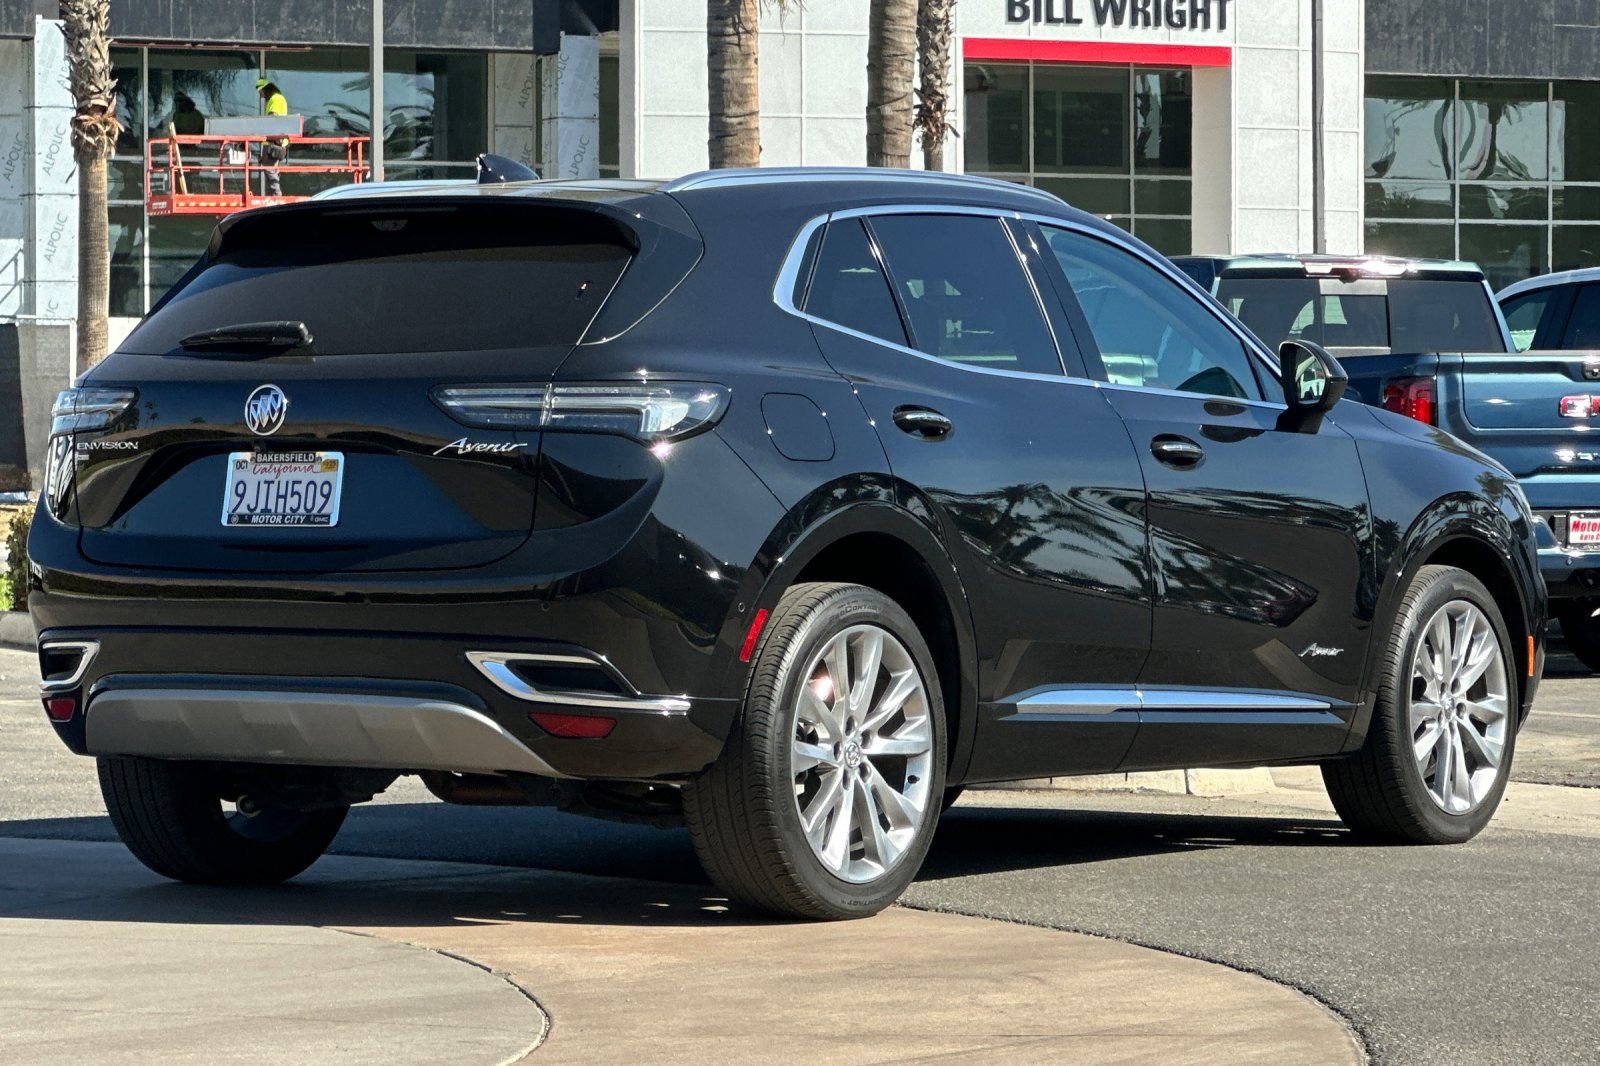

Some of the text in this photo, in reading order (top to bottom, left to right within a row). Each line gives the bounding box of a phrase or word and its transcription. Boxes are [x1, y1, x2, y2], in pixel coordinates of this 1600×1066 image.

[1006, 0, 1231, 30] BILL WRIGHT
[3, 132, 24, 181] ALPOLIC
[42, 125, 66, 176] ALPOLIC
[43, 210, 68, 263] ALPOLIC
[76, 441, 139, 450] ENVISION
[433, 437, 528, 455] Avenir
[256, 453, 315, 463] BAKERSFIELD
[252, 463, 320, 479] California
[232, 480, 333, 514] 9JIH509
[251, 515, 307, 524] MOTOR CITY
